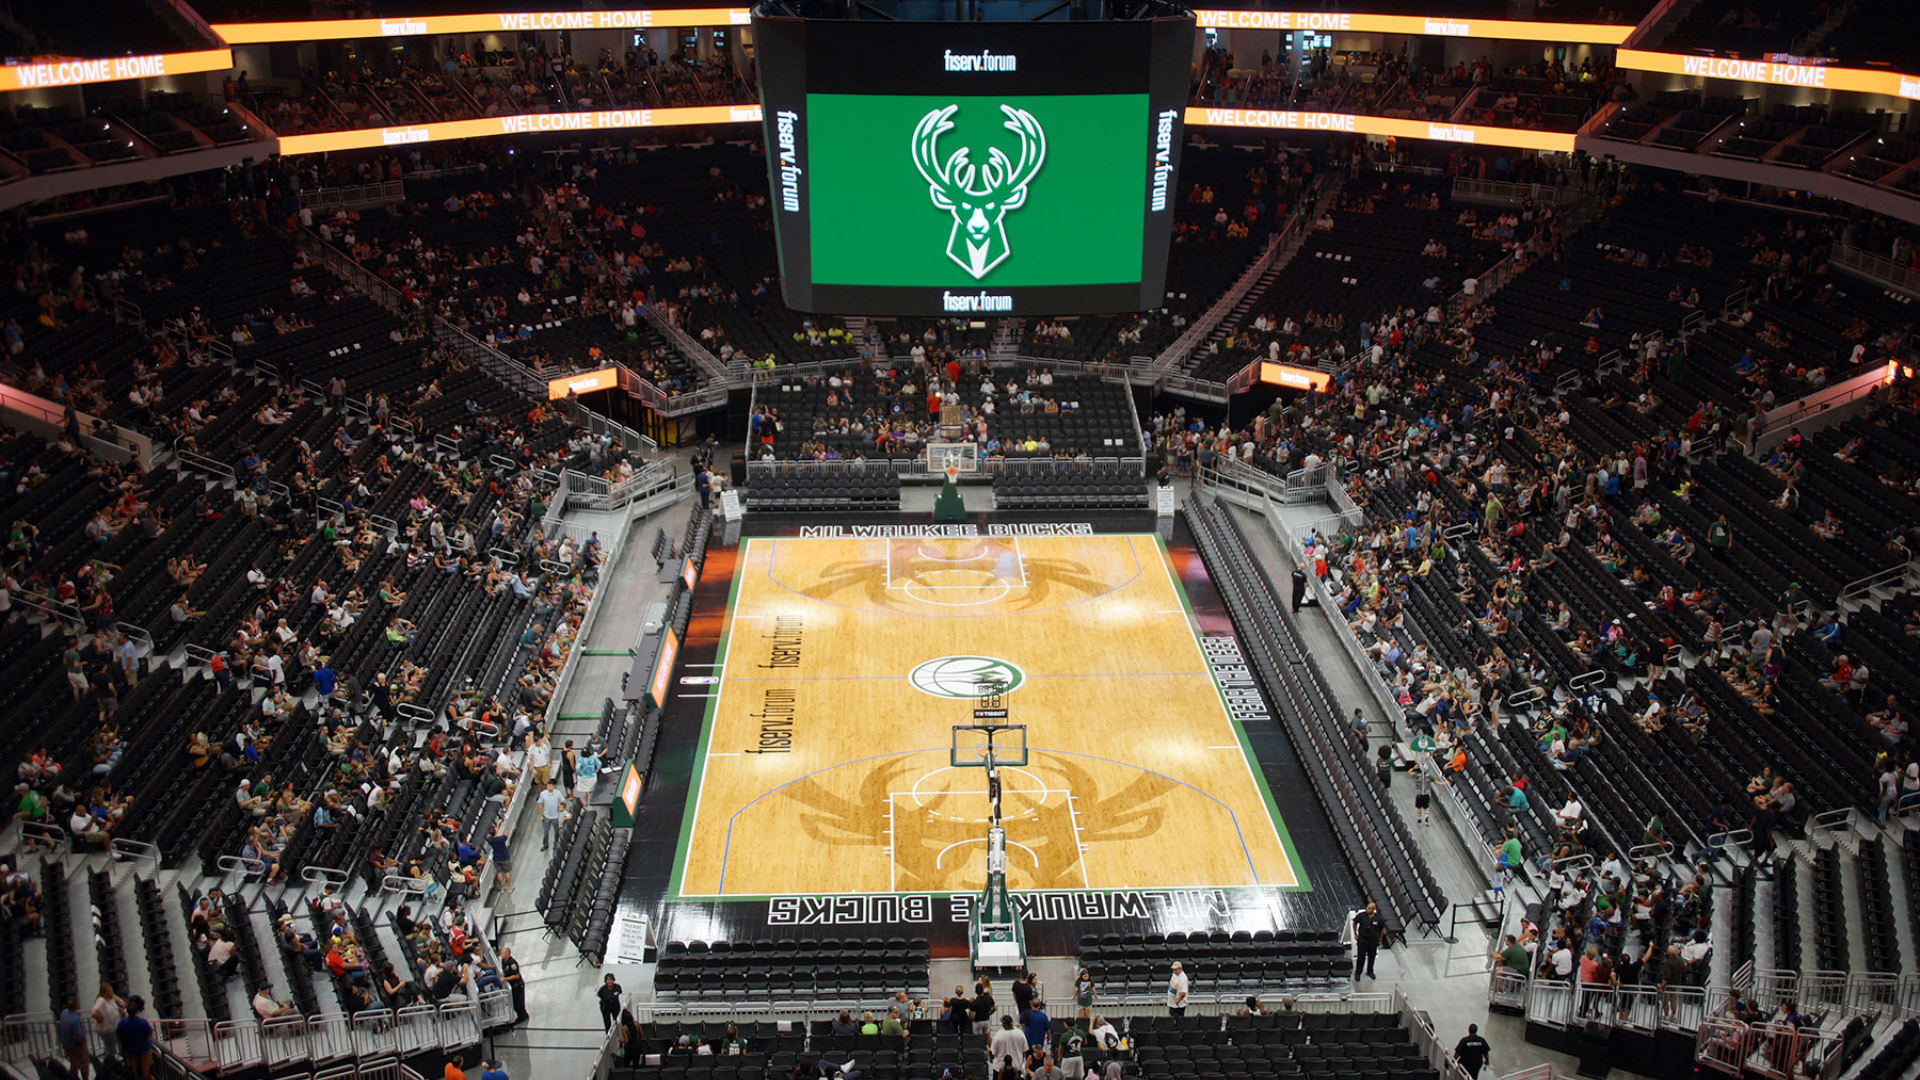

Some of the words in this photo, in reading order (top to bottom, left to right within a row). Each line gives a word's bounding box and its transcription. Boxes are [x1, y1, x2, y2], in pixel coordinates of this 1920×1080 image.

[500, 12, 592, 29] WELCOME
[599, 10, 653, 27] HOME
[1200, 11, 1289, 28] WELCOME
[1297, 14, 1350, 29] HOME
[16, 59, 111, 87] WELCOME
[115, 55, 165, 78] HOME
[944, 49, 1016, 72] fiserv.forum
[1684, 56, 1766, 83] WELCOME
[1772, 64, 1827, 87] HOME
[501, 114, 592, 133] WELCOME
[598, 111, 652, 129] HOME
[1206, 110, 1297, 128] WELCOME
[1304, 113, 1355, 131] HOME
[777, 110, 800, 212] fiserv.forum
[1151, 109, 1178, 212] fiserv.forum
[943, 291, 1012, 312] fiserv.forum
[799, 523, 978, 539] MILWAUKEE
[988, 522, 1093, 536] BUCKS
[1200, 636, 1244, 664] DEER
[1212, 665, 1255, 688] THE
[1222, 688, 1271, 720] FEAR
[745, 689, 796, 754] fiserv.forum
[767, 894, 932, 925] BUCKS
[950, 889, 1230, 922] MILWAUKE
